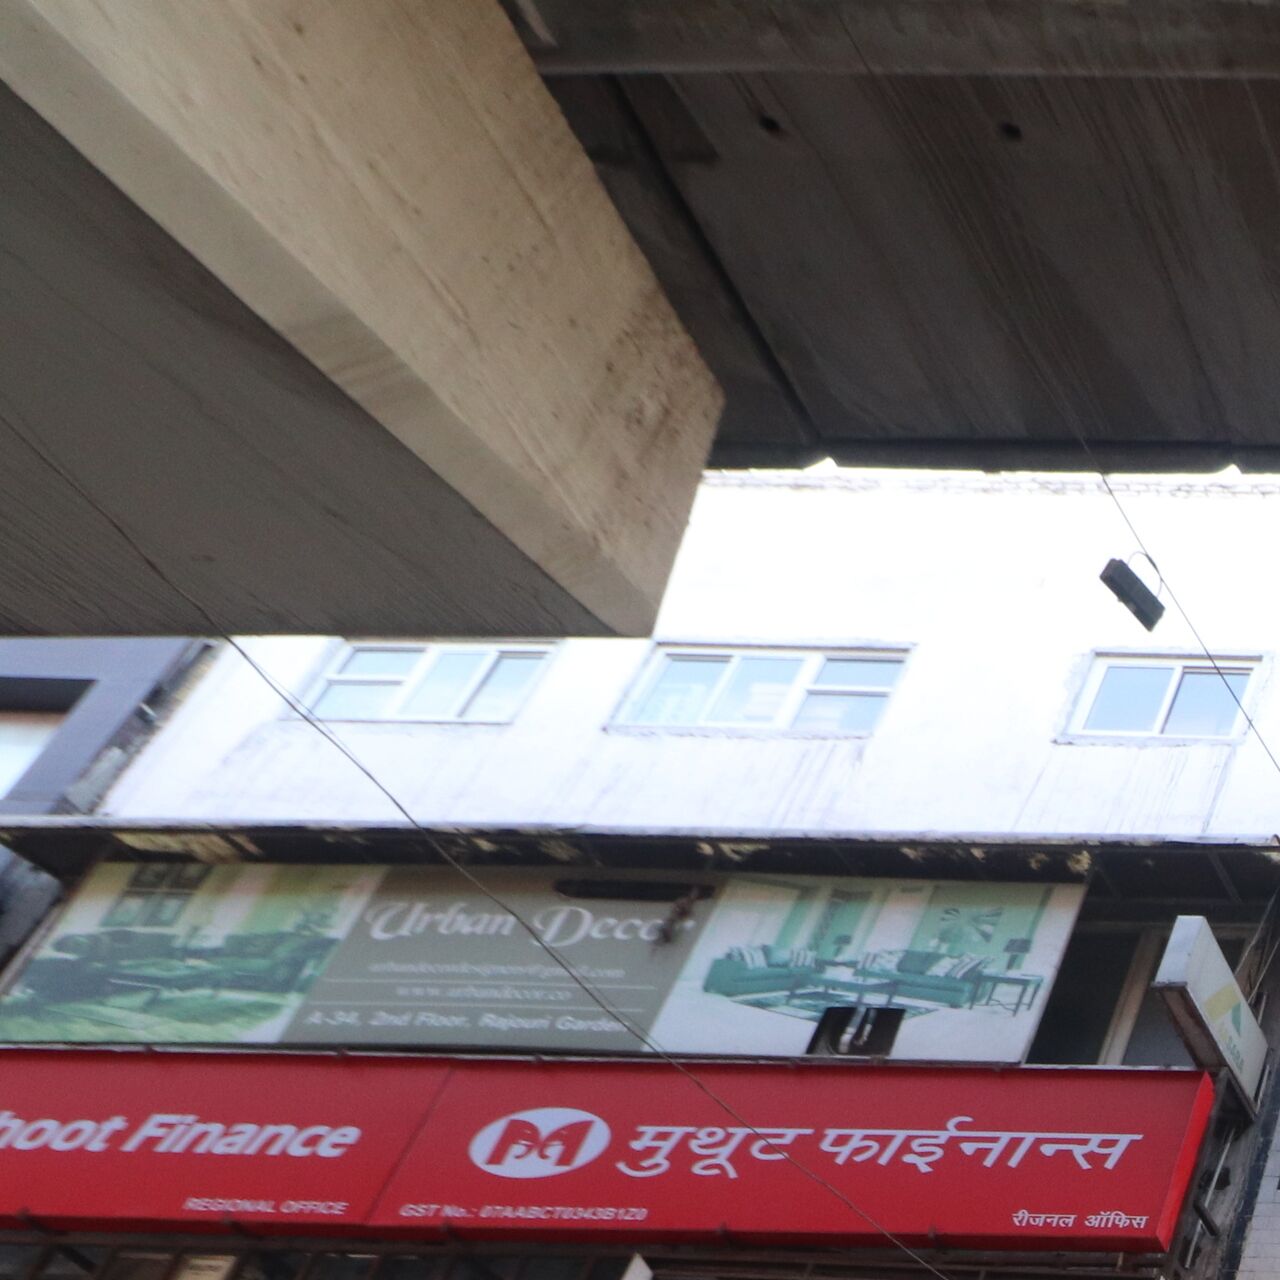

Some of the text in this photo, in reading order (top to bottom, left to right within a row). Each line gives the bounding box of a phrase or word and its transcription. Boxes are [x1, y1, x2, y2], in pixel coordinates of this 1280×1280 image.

[363, 903, 513, 941] Urban
[120, 1113, 362, 1158] Finance
[616, 1115, 1143, 1179] मुथूट फाईनान्स
[183, 1197, 349, 1216] REGIONAL OFFICE
[399, 1203, 438, 1218] GST
[1011, 1208, 1148, 1231] रीजनल ऑफिस
